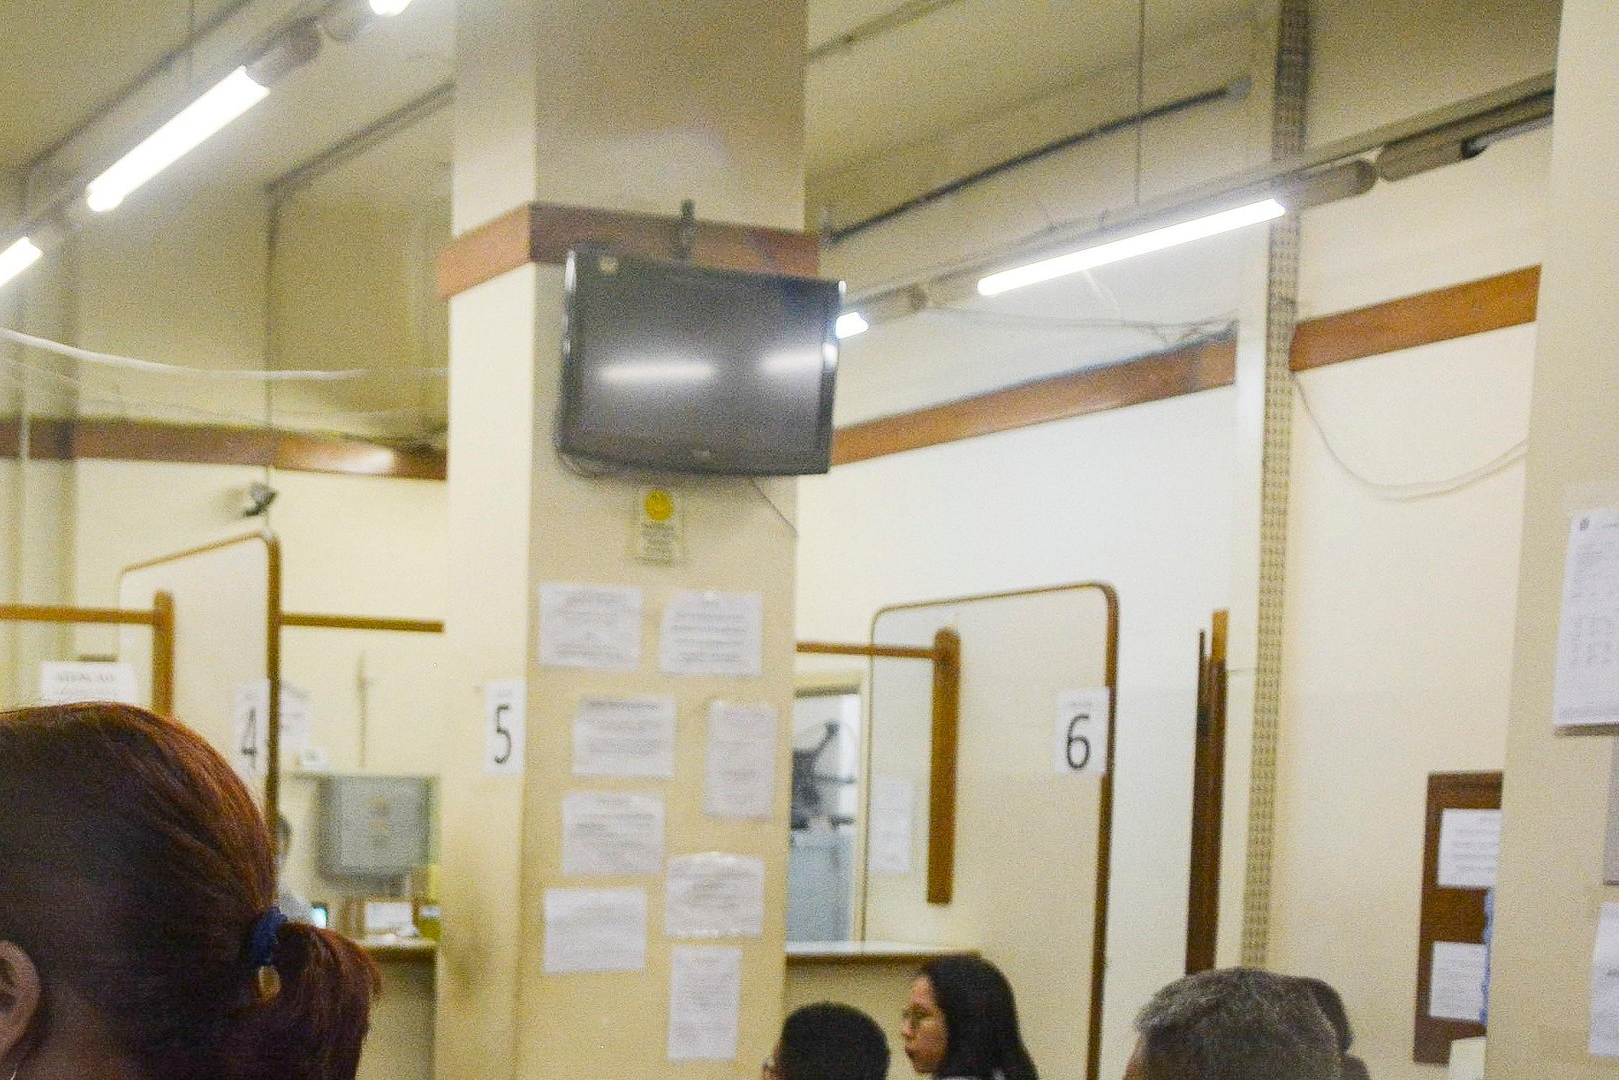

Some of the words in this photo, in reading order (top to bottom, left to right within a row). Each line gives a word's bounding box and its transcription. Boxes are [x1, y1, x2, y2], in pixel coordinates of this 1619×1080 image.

[241, 706, 257, 771] 4
[494, 704, 512, 764] 5
[1067, 714, 1091, 770] 6
